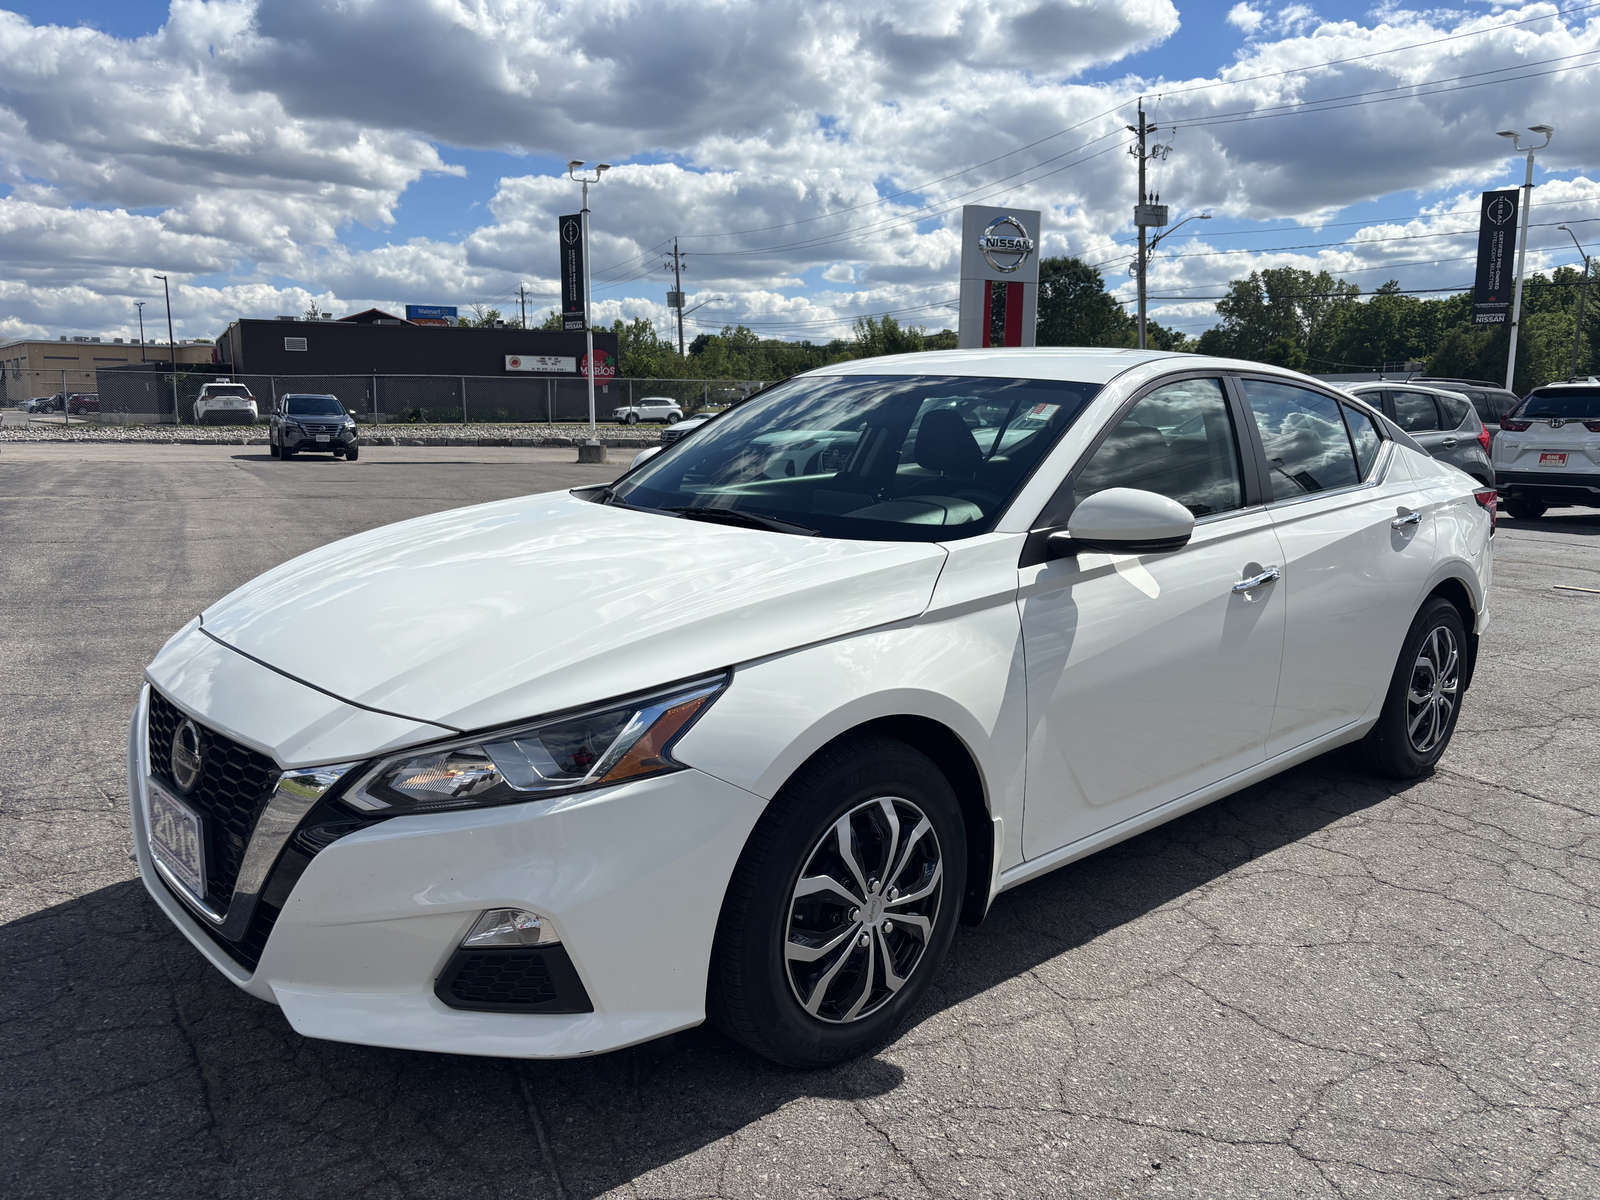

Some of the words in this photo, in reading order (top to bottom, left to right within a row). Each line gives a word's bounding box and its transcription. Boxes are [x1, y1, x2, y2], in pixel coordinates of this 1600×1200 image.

[1496, 195, 1505, 226] NISSAN
[985, 238, 1030, 250] NISSAN
[1494, 258, 1502, 291] PRE-OWNED
[580, 366, 616, 376] MRIOS
[153, 800, 200, 872] 2019
